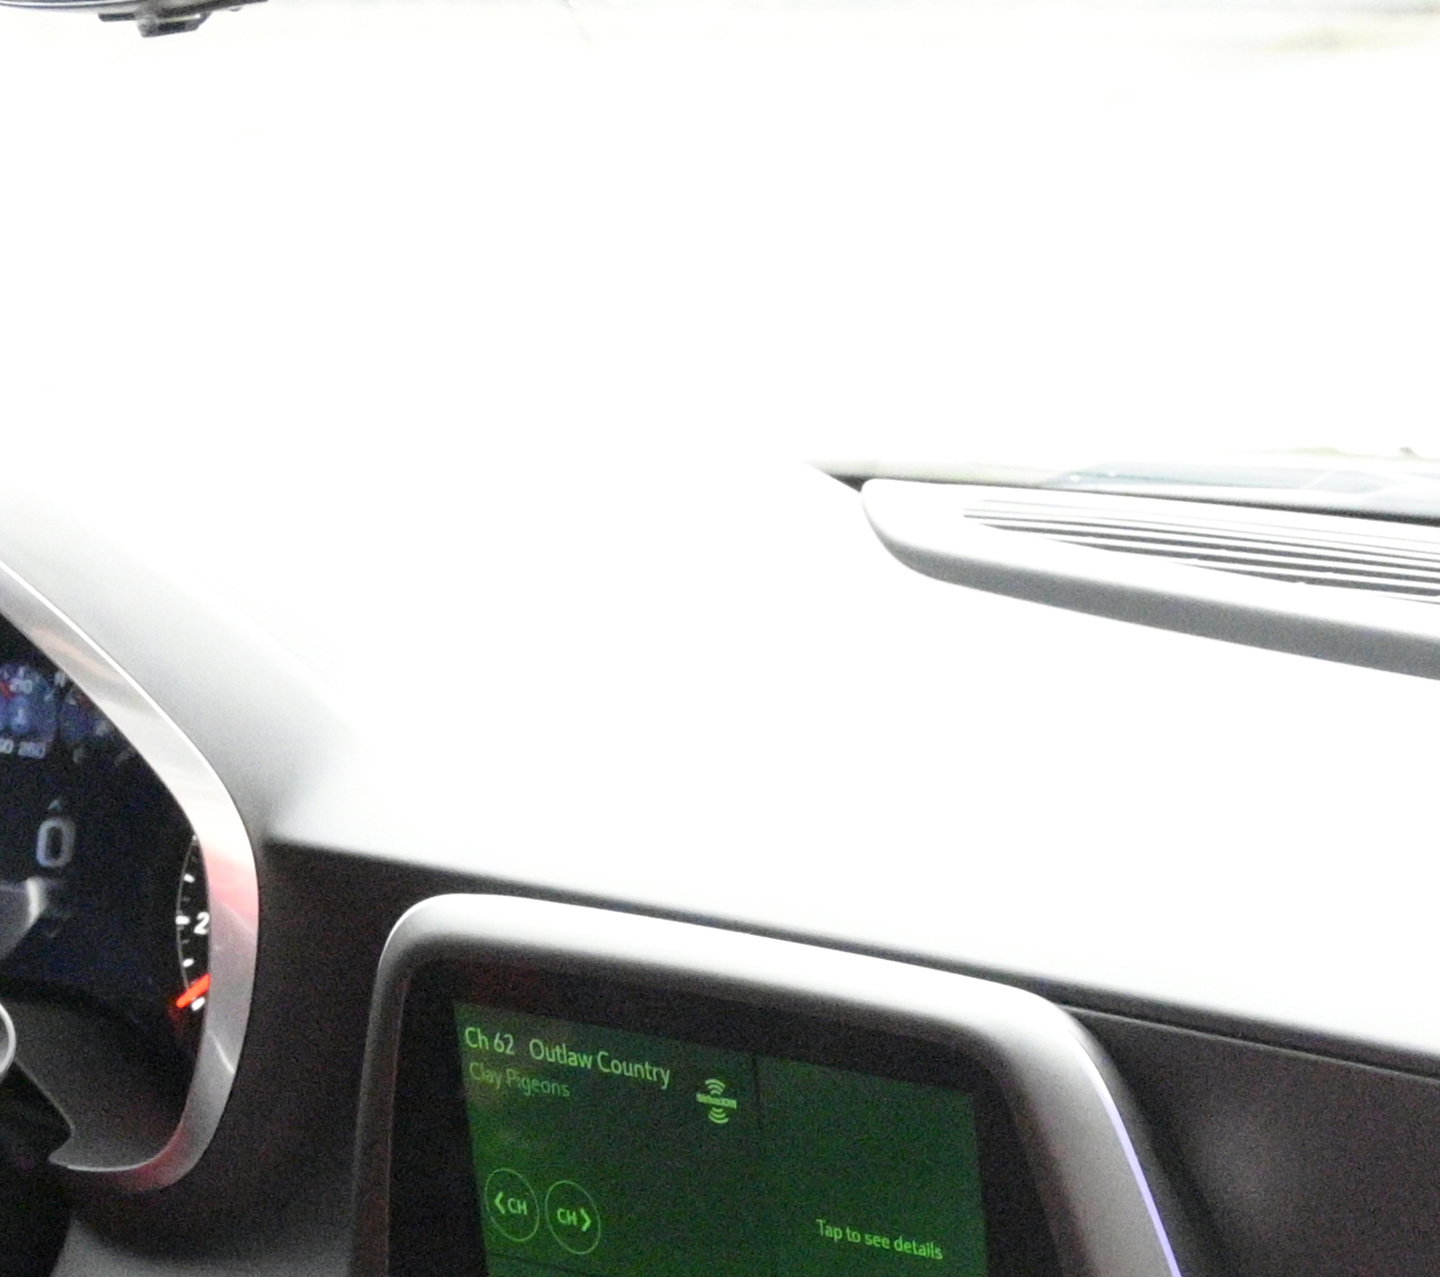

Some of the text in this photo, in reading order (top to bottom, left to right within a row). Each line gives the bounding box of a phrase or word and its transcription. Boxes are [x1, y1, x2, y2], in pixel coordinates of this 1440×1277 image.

[464, 1026, 671, 1090] Ch 62 Outlaw Country
[469, 1061, 570, 1097] Clay Pigeons
[507, 1197, 528, 1215] CH
[556, 1207, 577, 1226] CH
[816, 1218, 943, 1260] Tap to see details
